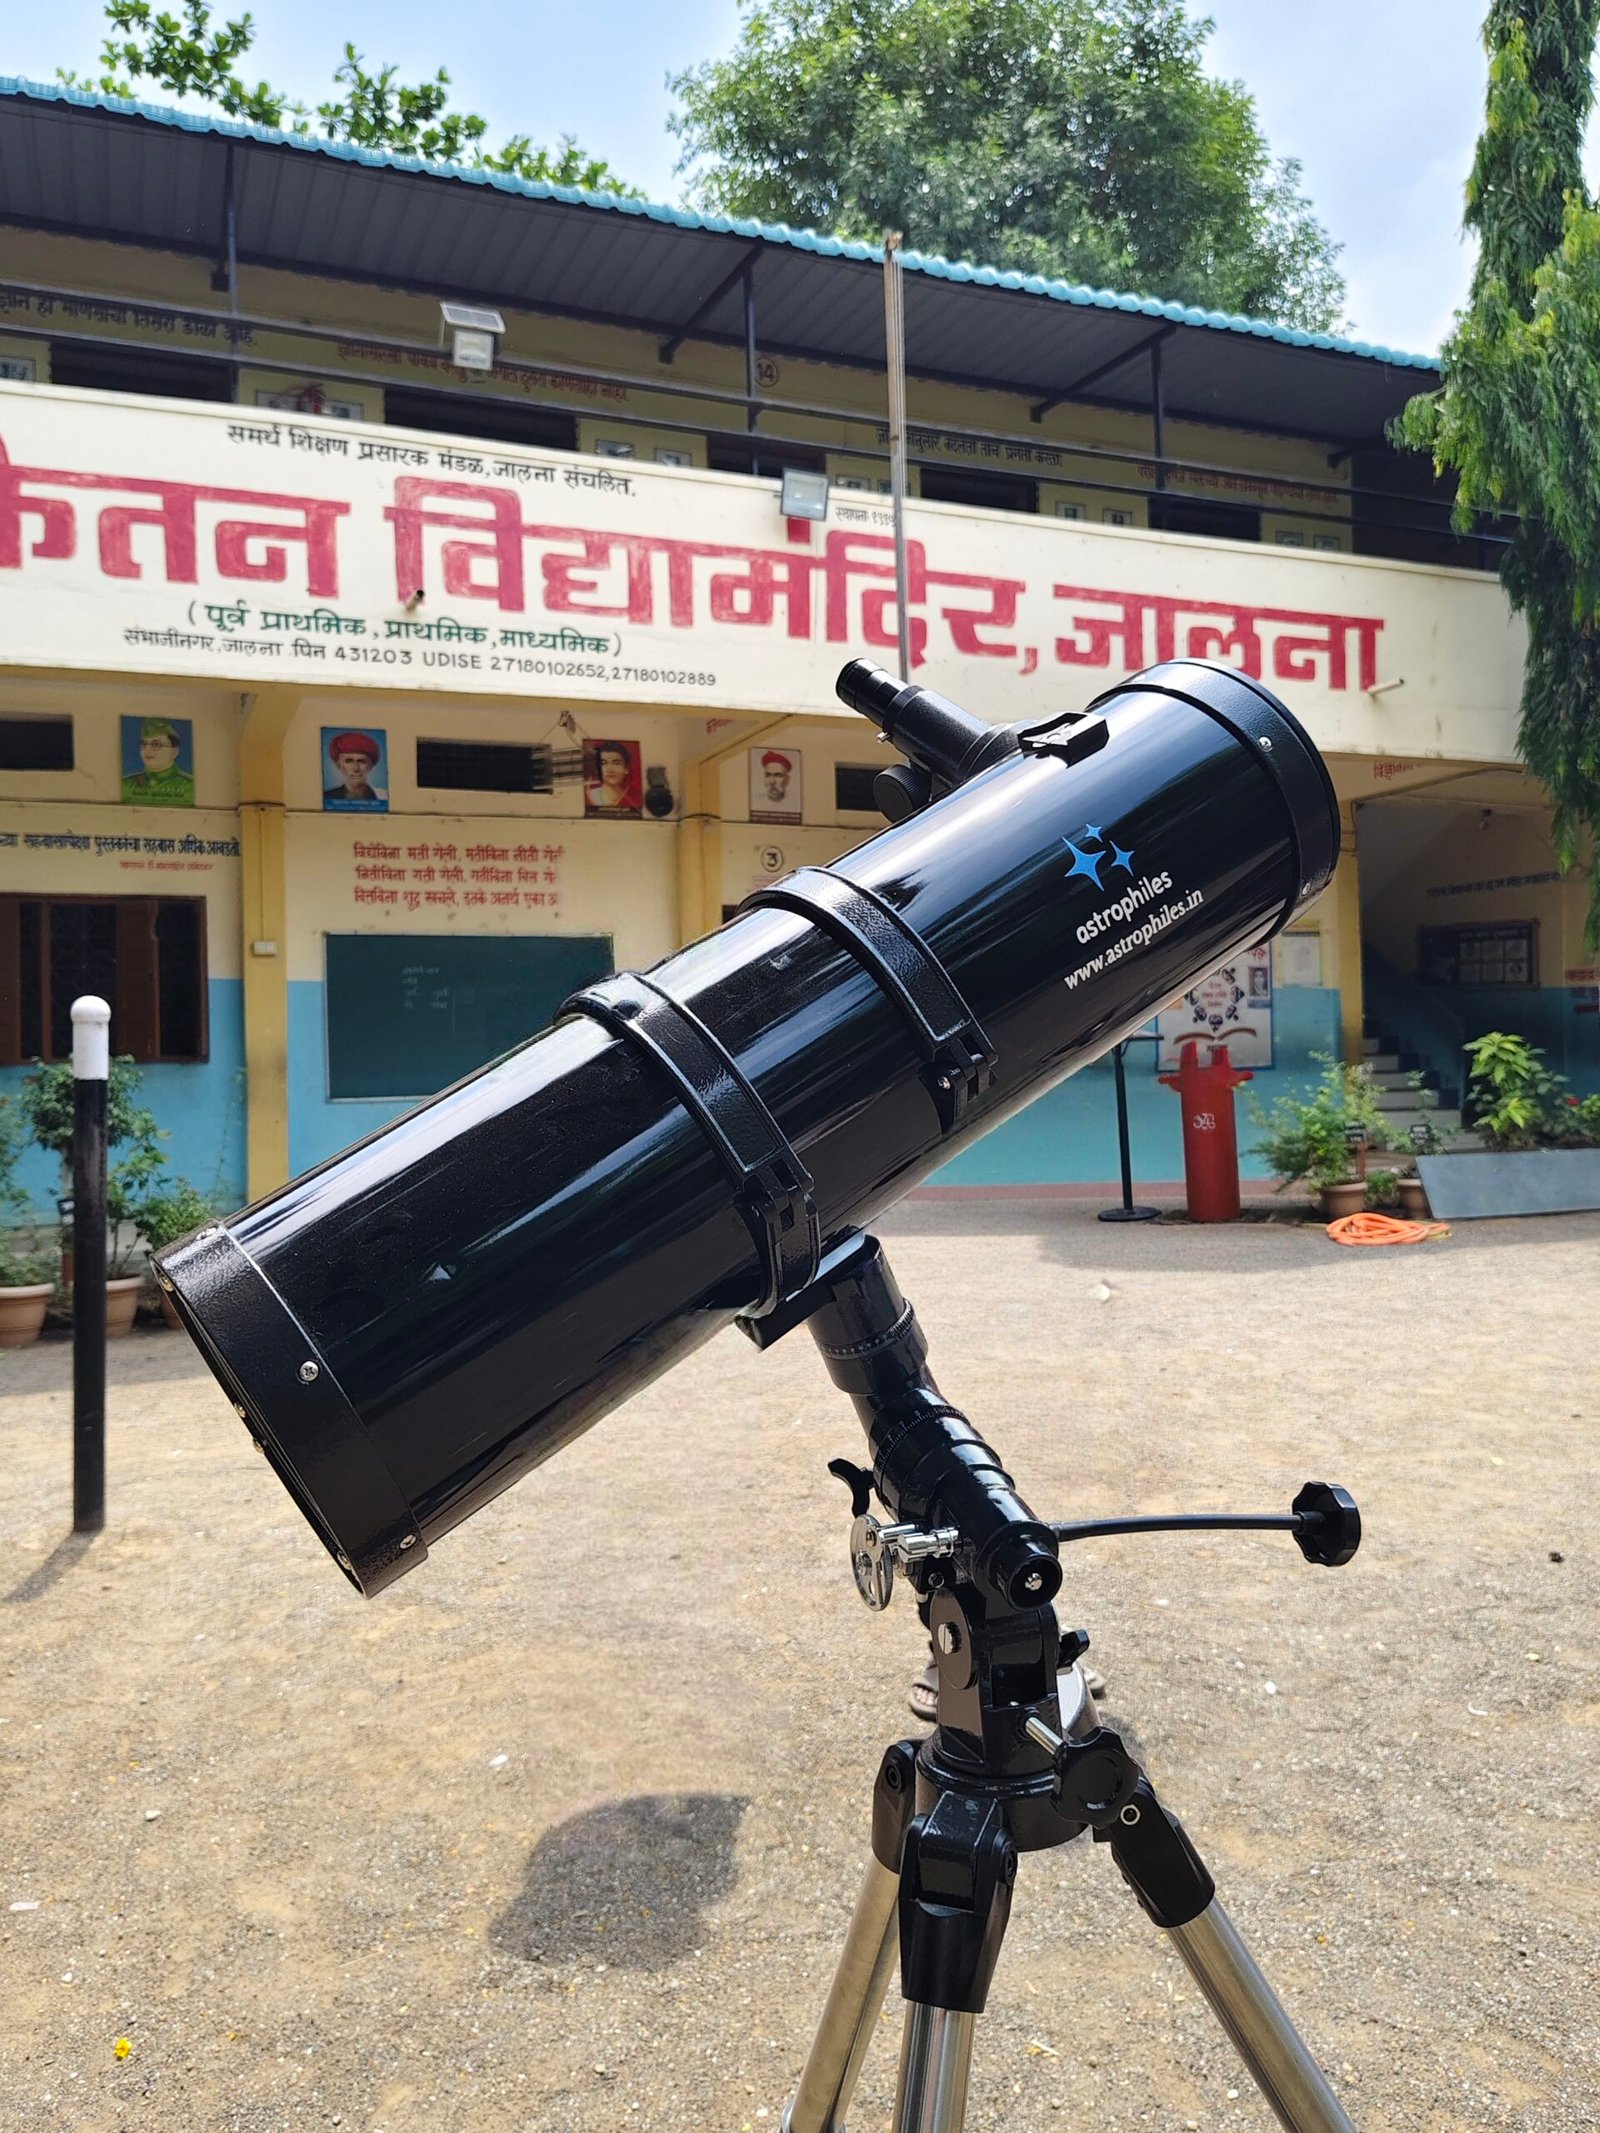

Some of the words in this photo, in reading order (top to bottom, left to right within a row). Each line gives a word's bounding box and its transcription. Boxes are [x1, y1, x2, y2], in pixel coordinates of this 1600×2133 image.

[228, 424, 281, 447] समर्थ
[288, 425, 348, 457] शिक्षण
[357, 443, 429, 467] प्रसारक
[335, 645, 413, 666] 431203
[423, 650, 482, 670] UDISE
[1053, 584, 1384, 692] जालना
[1064, 888, 1204, 990] www.astrophiles.in
[1076, 871, 1173, 944] astrophiles
